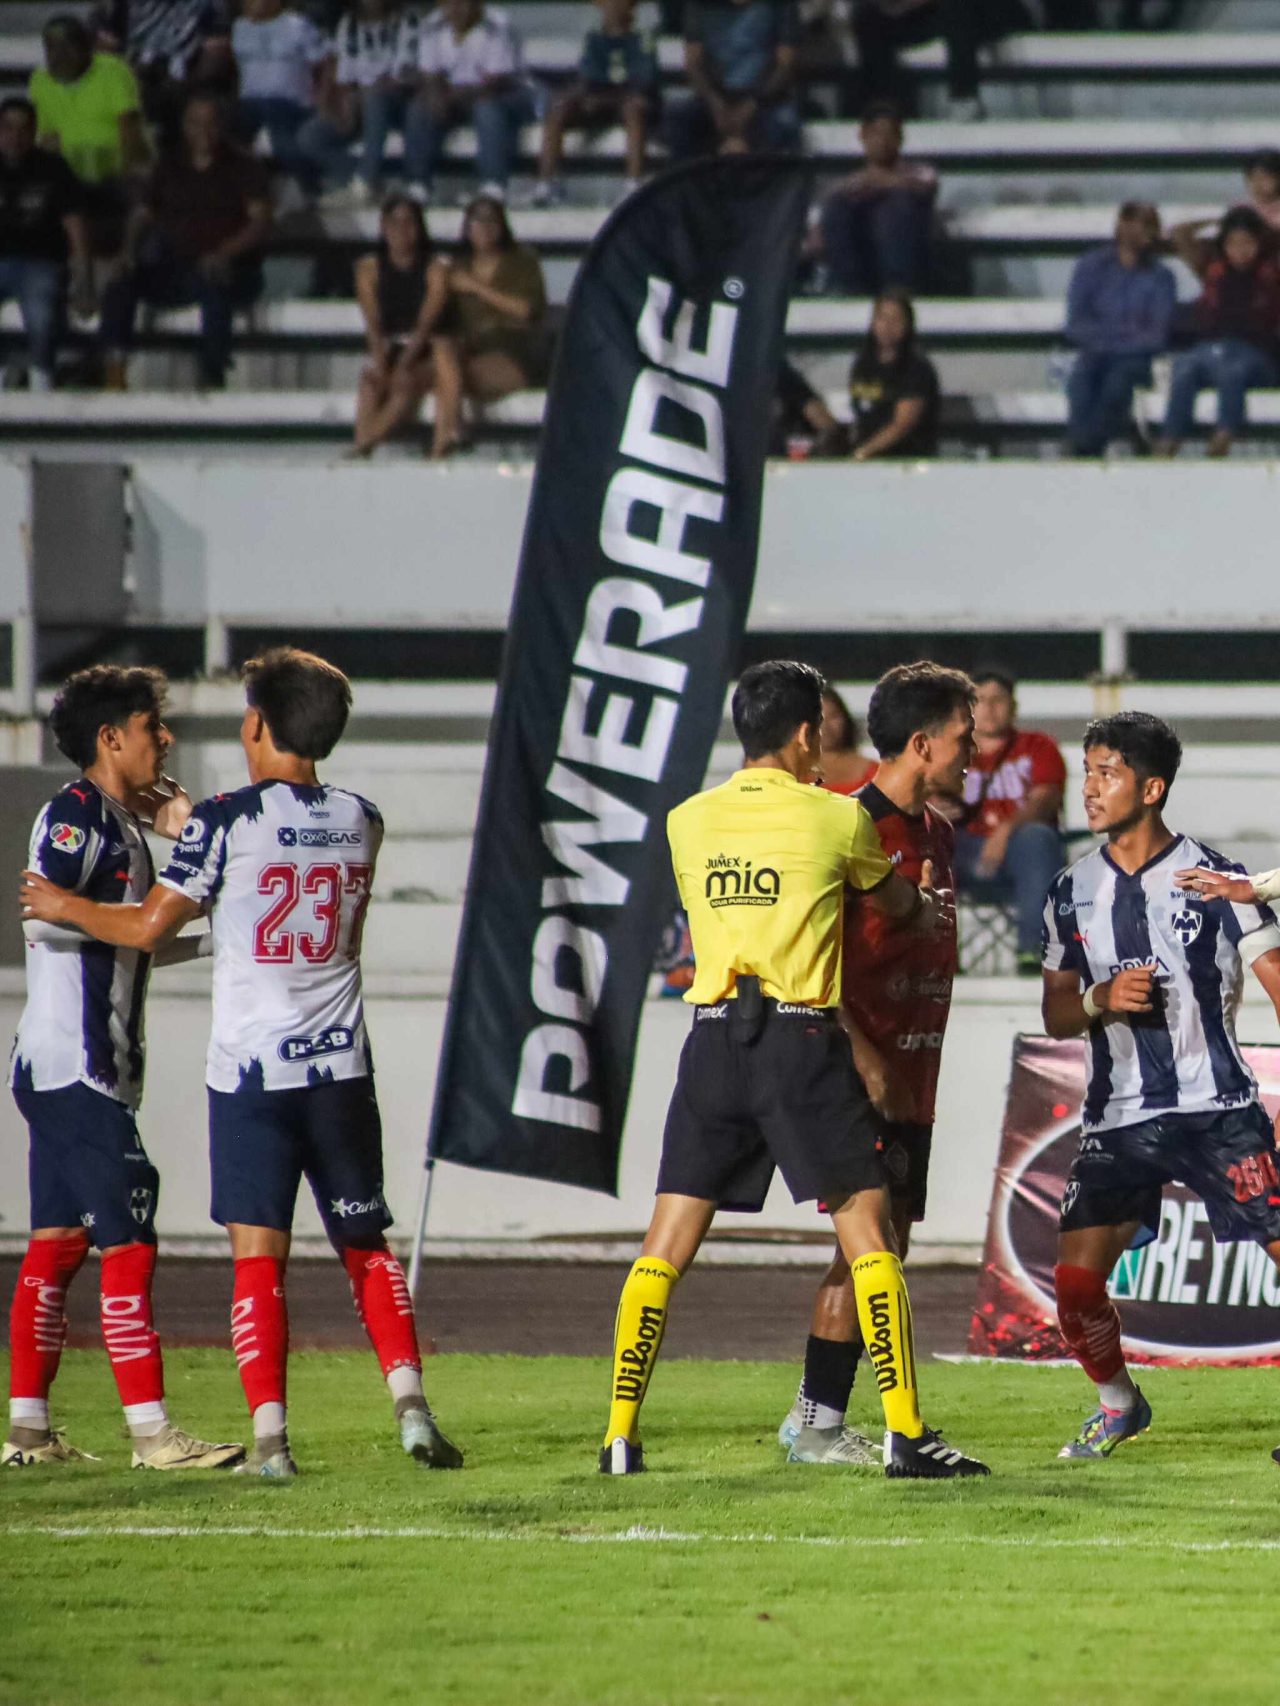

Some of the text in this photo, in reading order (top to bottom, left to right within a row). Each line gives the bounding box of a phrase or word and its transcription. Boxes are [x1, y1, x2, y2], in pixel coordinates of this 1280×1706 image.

[511, 276, 739, 1133] POWERADE
[705, 857, 741, 869] JUMEX
[696, 1003, 728, 1020] omex
[615, 1306, 664, 1402] Wilson
[868, 1291, 898, 1393] Wilson
